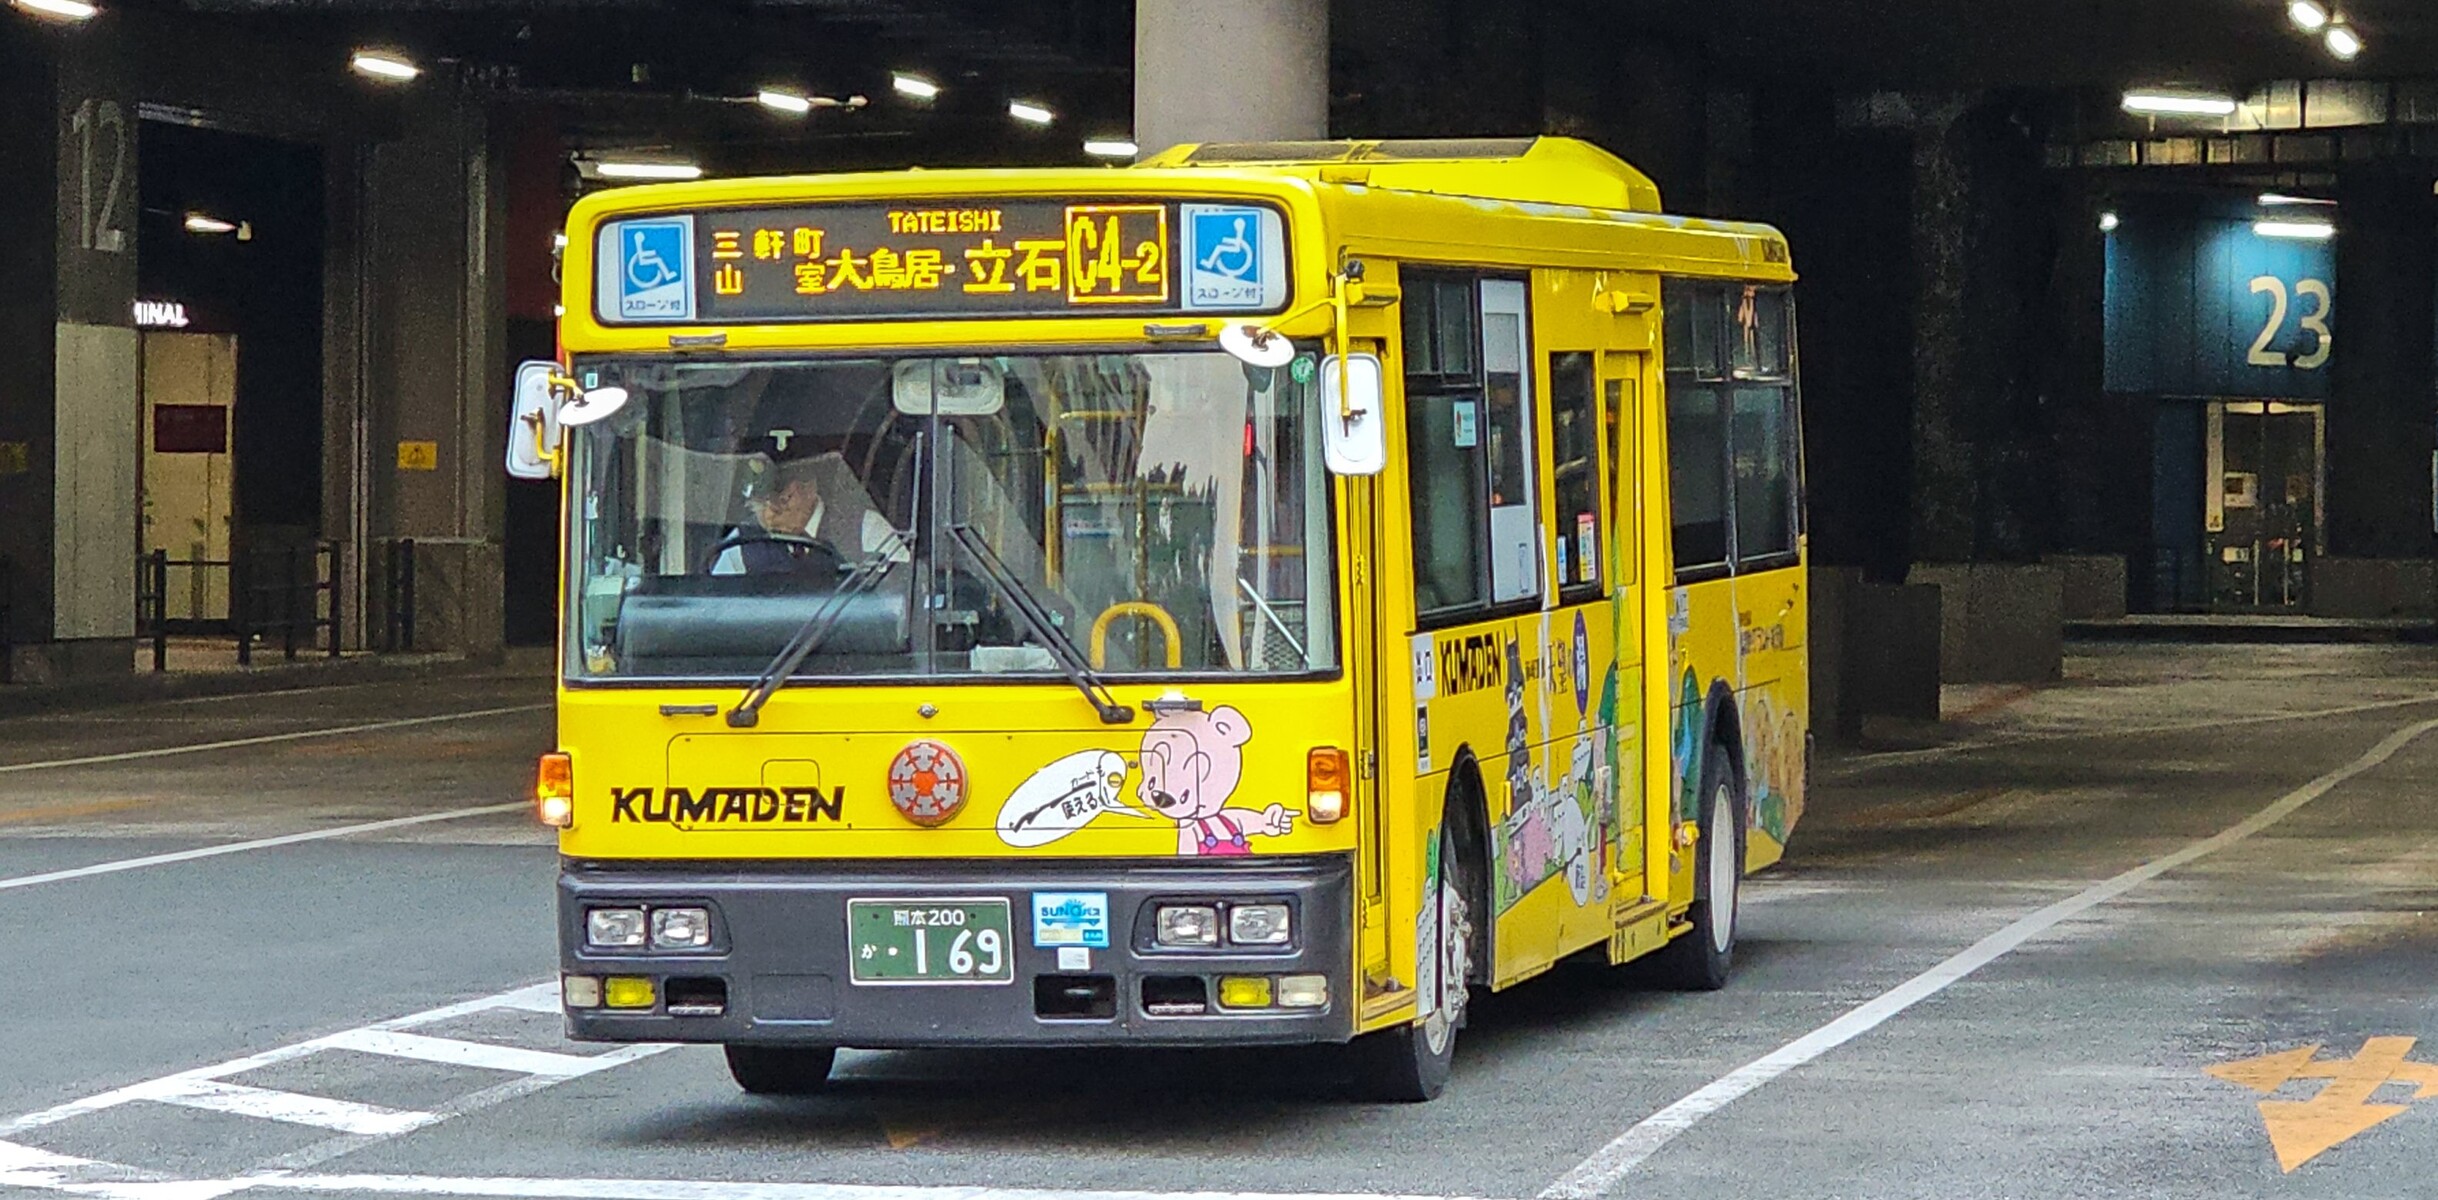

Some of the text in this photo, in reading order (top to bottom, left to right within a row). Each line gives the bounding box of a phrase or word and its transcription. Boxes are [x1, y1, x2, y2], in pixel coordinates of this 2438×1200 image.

[73, 99, 126, 250] 12
[712, 227, 825, 259] 三軒町
[888, 210, 1002, 233] TATEISHI
[1072, 215, 1161, 293] C4-2
[2247, 276, 2333, 369] 23
[1439, 631, 1502, 698] KUMADEN
[611, 786, 846, 823] KUMADEN
